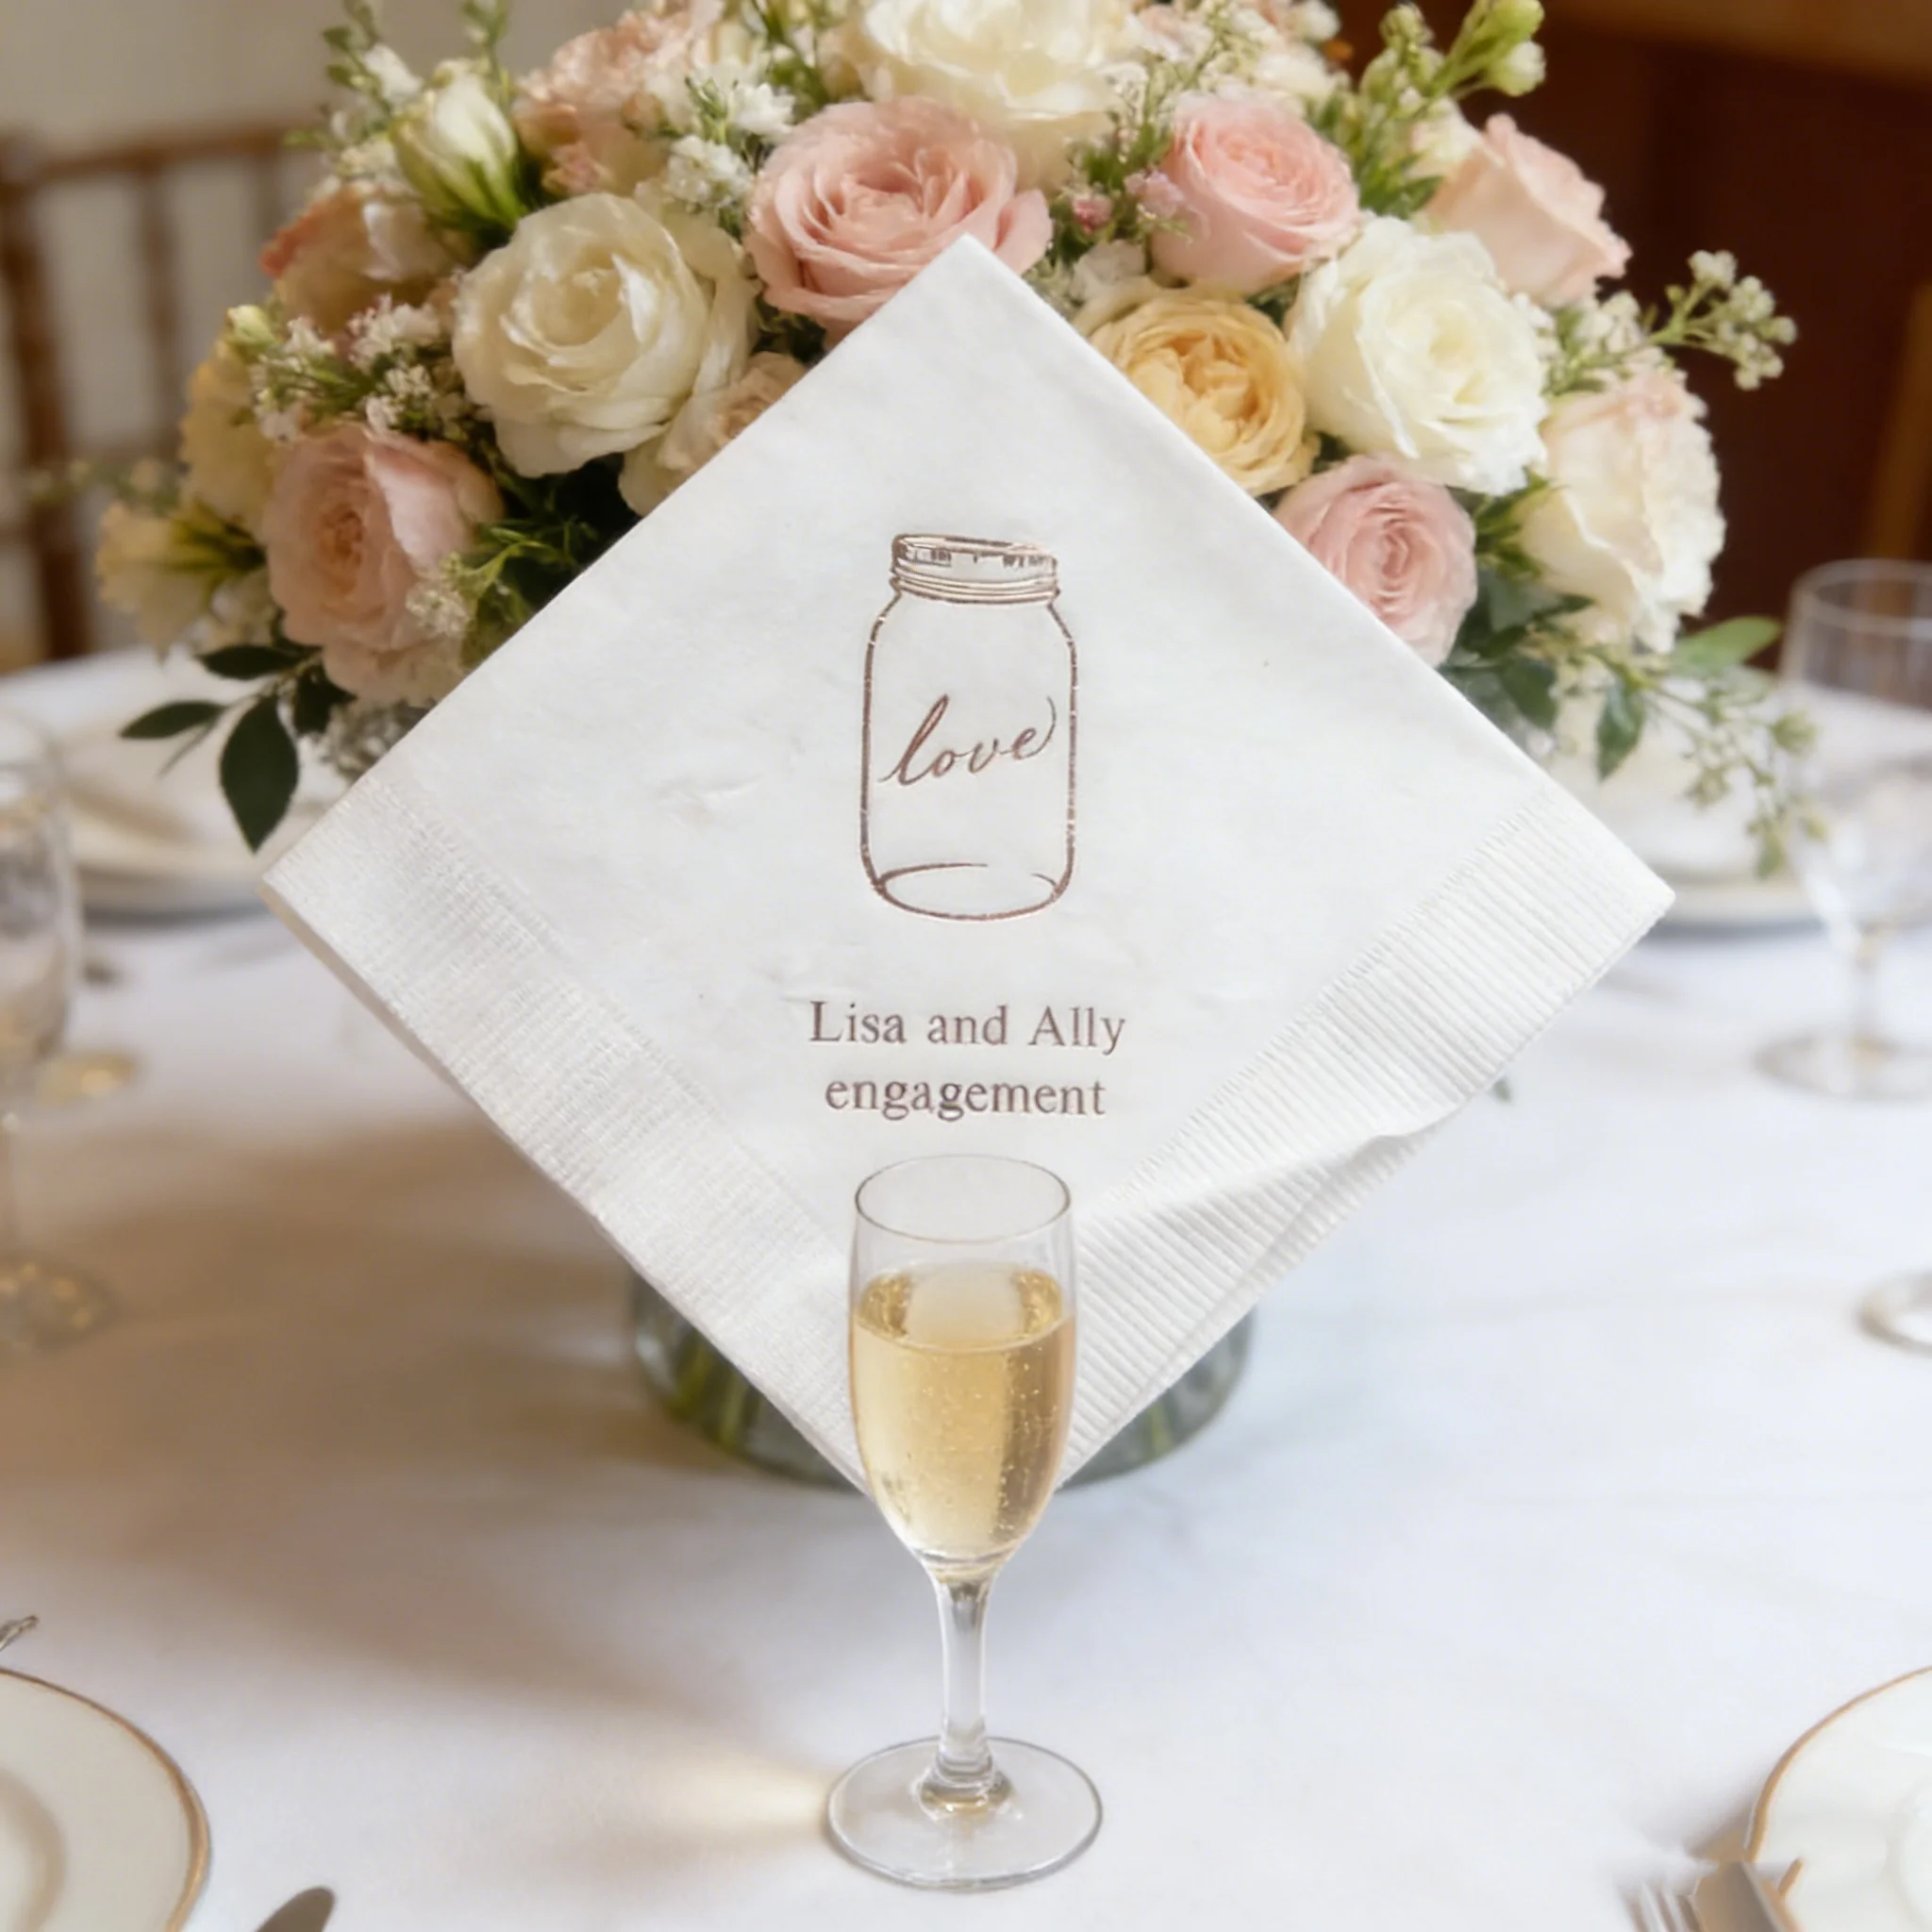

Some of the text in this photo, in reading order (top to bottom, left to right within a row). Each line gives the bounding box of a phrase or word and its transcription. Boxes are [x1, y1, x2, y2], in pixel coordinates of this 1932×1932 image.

[879, 692, 1058, 786] love
[808, 1000, 1126, 1056] Lisa and Ally
[824, 1079, 1107, 1123] engagement
